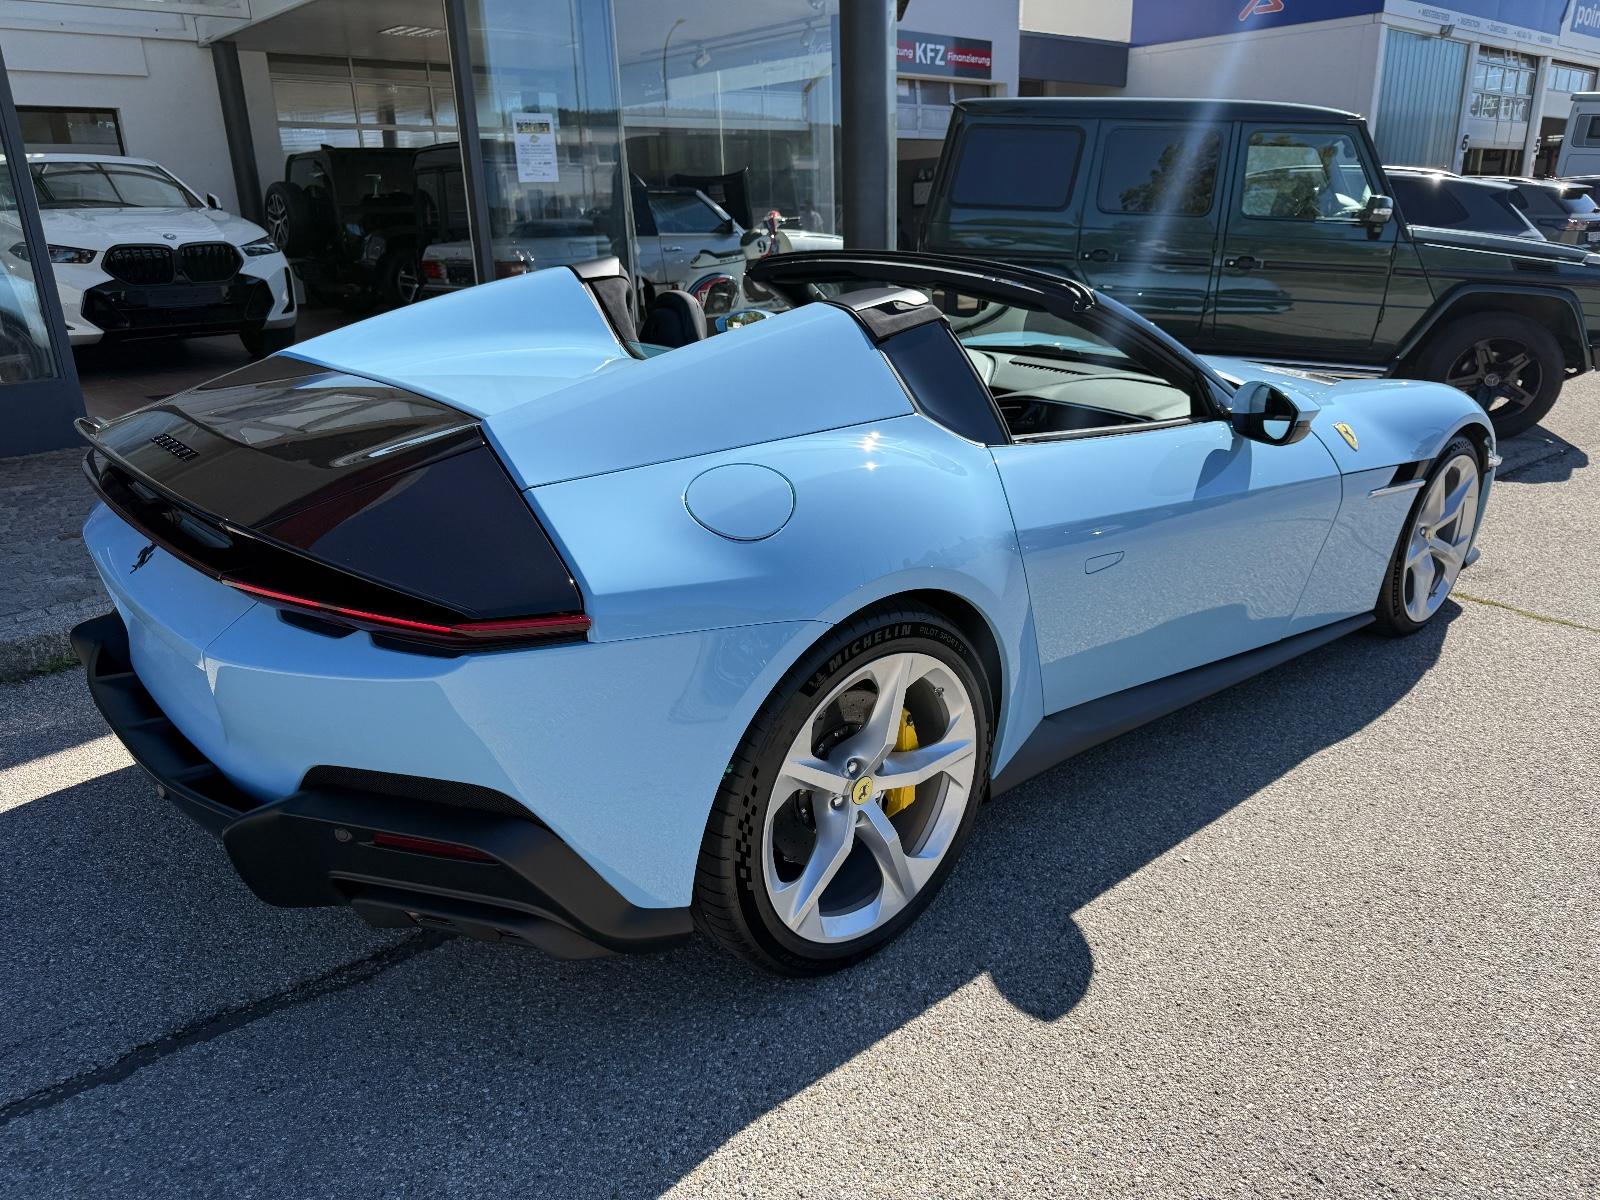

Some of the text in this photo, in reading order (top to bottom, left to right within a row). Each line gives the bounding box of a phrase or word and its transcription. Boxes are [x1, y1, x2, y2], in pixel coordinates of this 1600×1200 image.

[915, 42, 945, 66] KFZ
[947, 51, 990, 66] Finanzierung
[1461, 134, 1470, 151] 6
[757, 240, 767, 253] 9
[829, 624, 912, 673] MICHELIN
[919, 626, 939, 637] PILOT
[939, 631, 959, 647] SPORT
